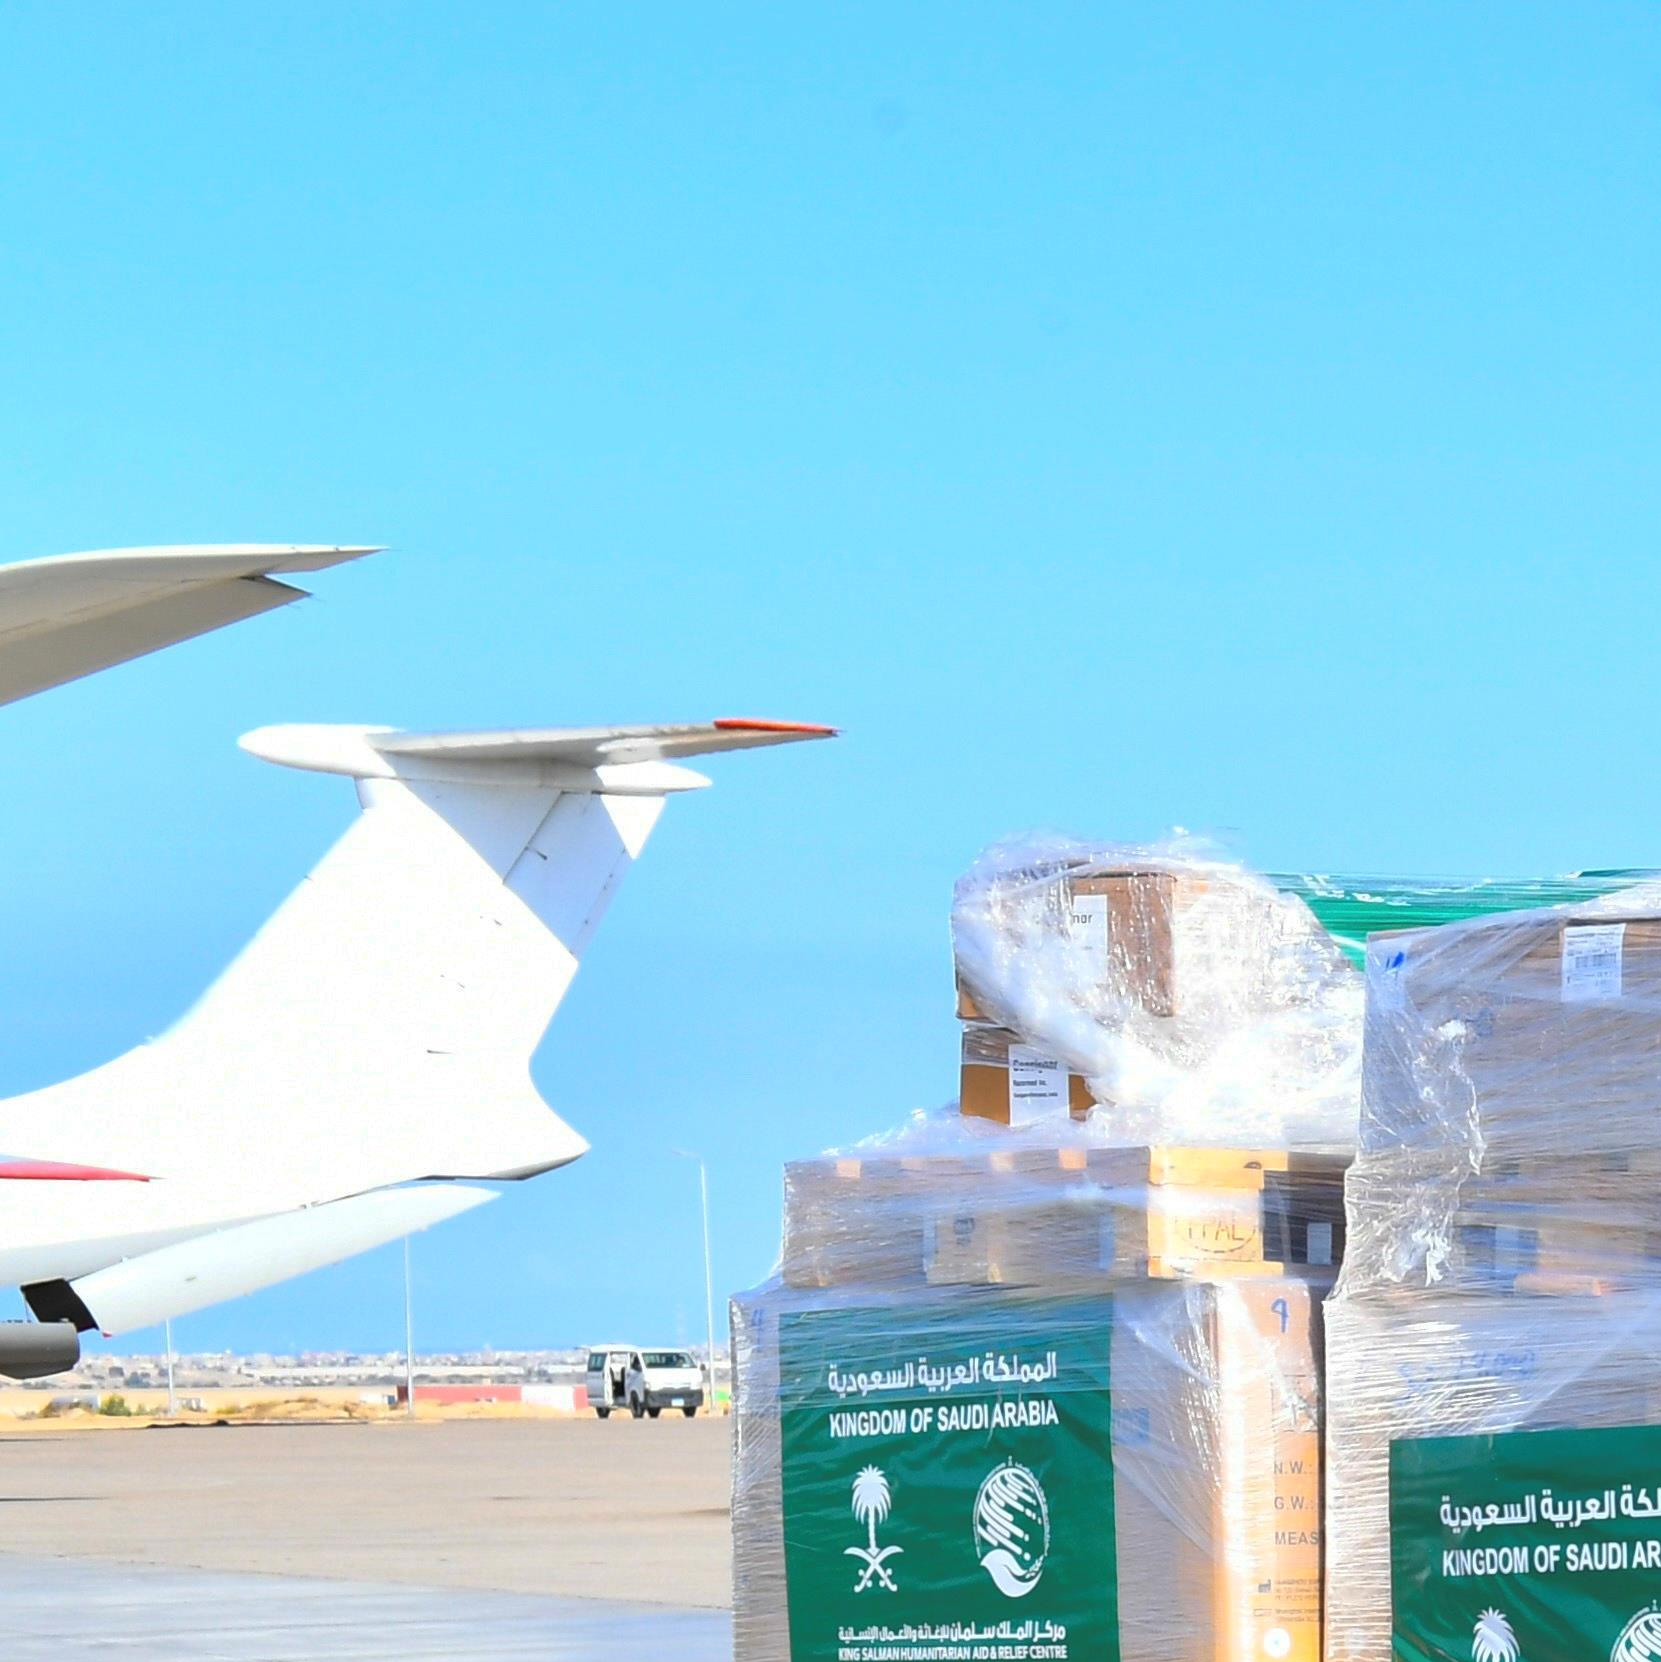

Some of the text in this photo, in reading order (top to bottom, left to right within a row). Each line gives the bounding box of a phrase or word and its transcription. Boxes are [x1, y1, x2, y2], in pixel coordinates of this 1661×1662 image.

[828, 1352, 1057, 1399] المملكة العربية السعودية
[829, 1400, 1059, 1438] KINGDOM OF SAUDI ARABIA
[1440, 1495, 1537, 1533] السعودية
[1540, 1489, 1616, 1528] العربية
[1442, 1546, 1529, 1577] KINGDOM
[1534, 1545, 1560, 1573] OF
[1566, 1542, 1627, 1571] SAUDI
[838, 1645, 1067, 1661] KING SALMAN HUMANITARIAN AID & RELIEF CENTRE
